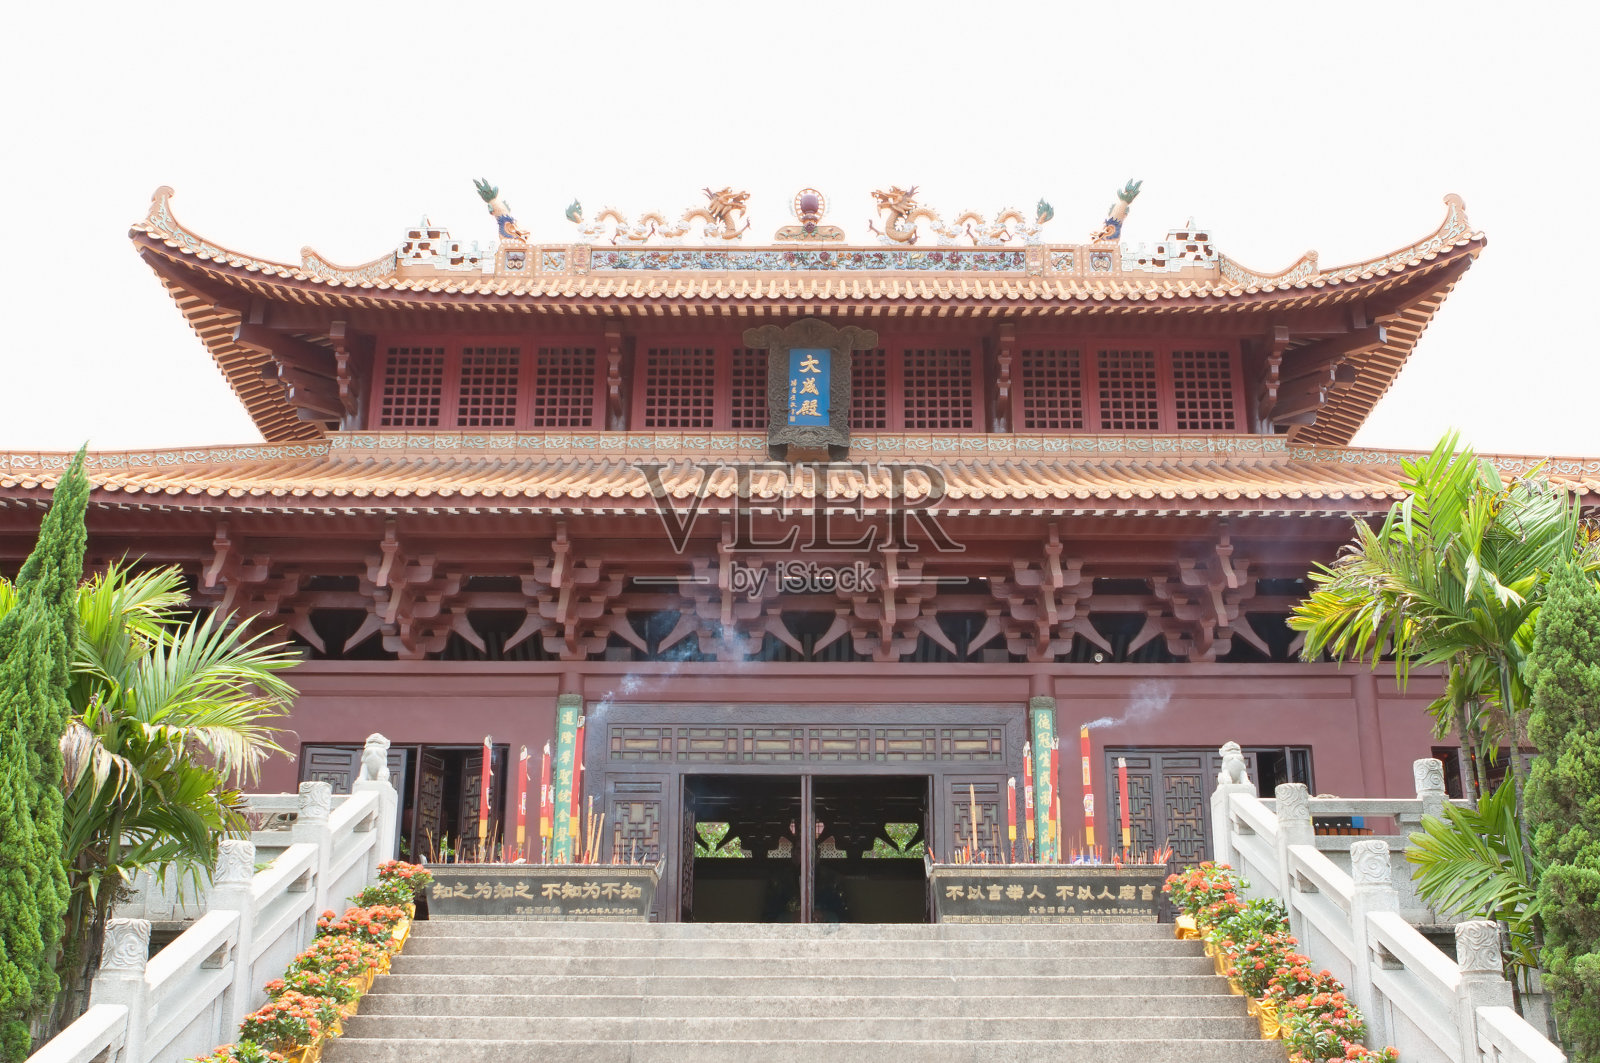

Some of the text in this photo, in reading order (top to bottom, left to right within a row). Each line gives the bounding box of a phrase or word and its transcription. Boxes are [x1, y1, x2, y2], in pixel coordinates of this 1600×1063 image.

[796, 354, 822, 417] 大成殿
[432, 881, 642, 900] 知之为知之 不知为不知
